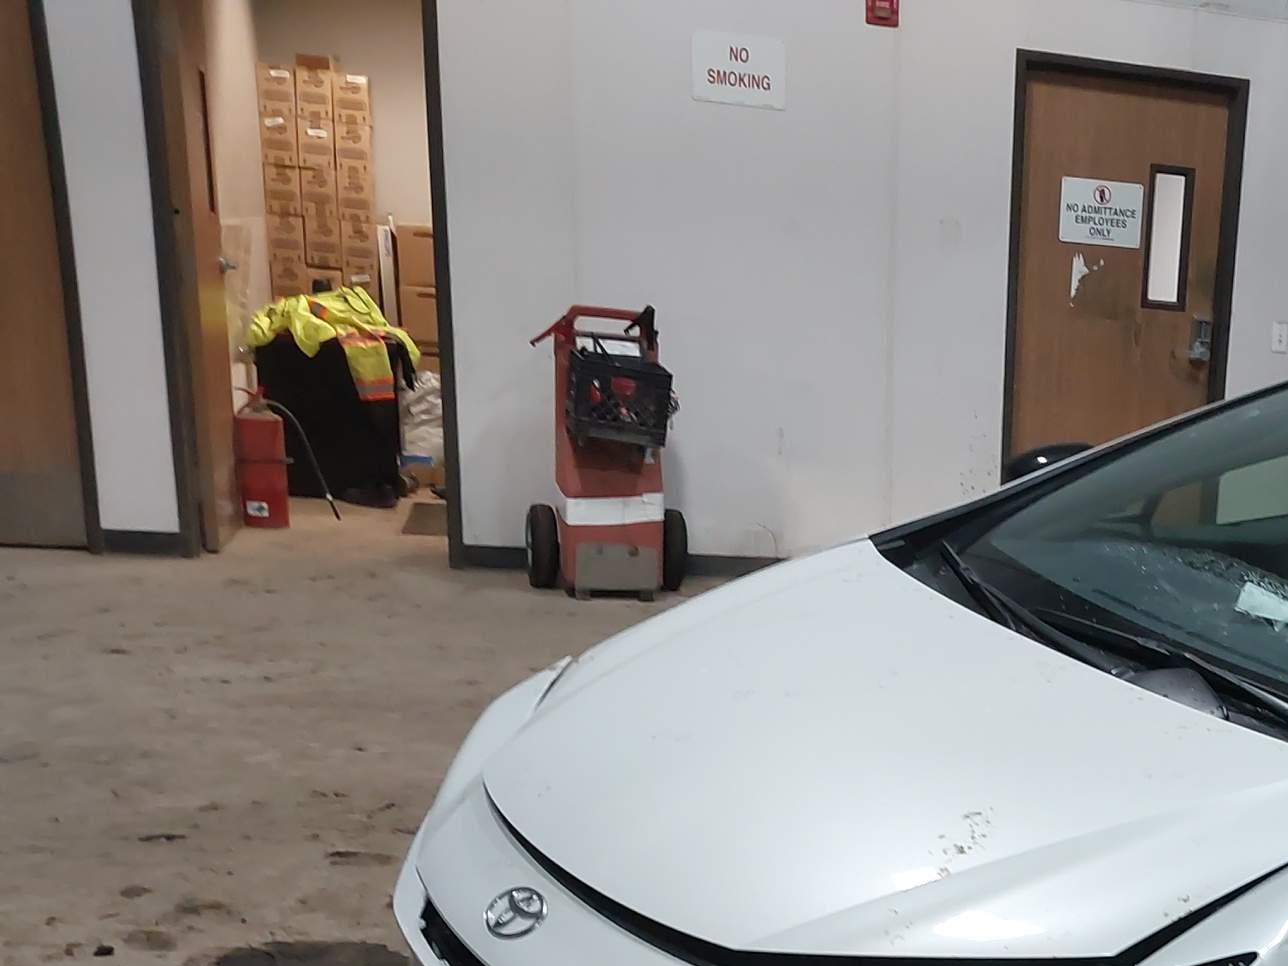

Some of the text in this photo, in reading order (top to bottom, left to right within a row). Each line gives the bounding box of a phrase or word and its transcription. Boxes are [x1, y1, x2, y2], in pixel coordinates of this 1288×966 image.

[729, 45, 750, 63] NO
[707, 67, 771, 91] SMOKING
[1065, 202, 1137, 219] NO ADMITTANCE
[1074, 214, 1128, 229] EMPLOYEES
[1088, 226, 1112, 237] ONLY
